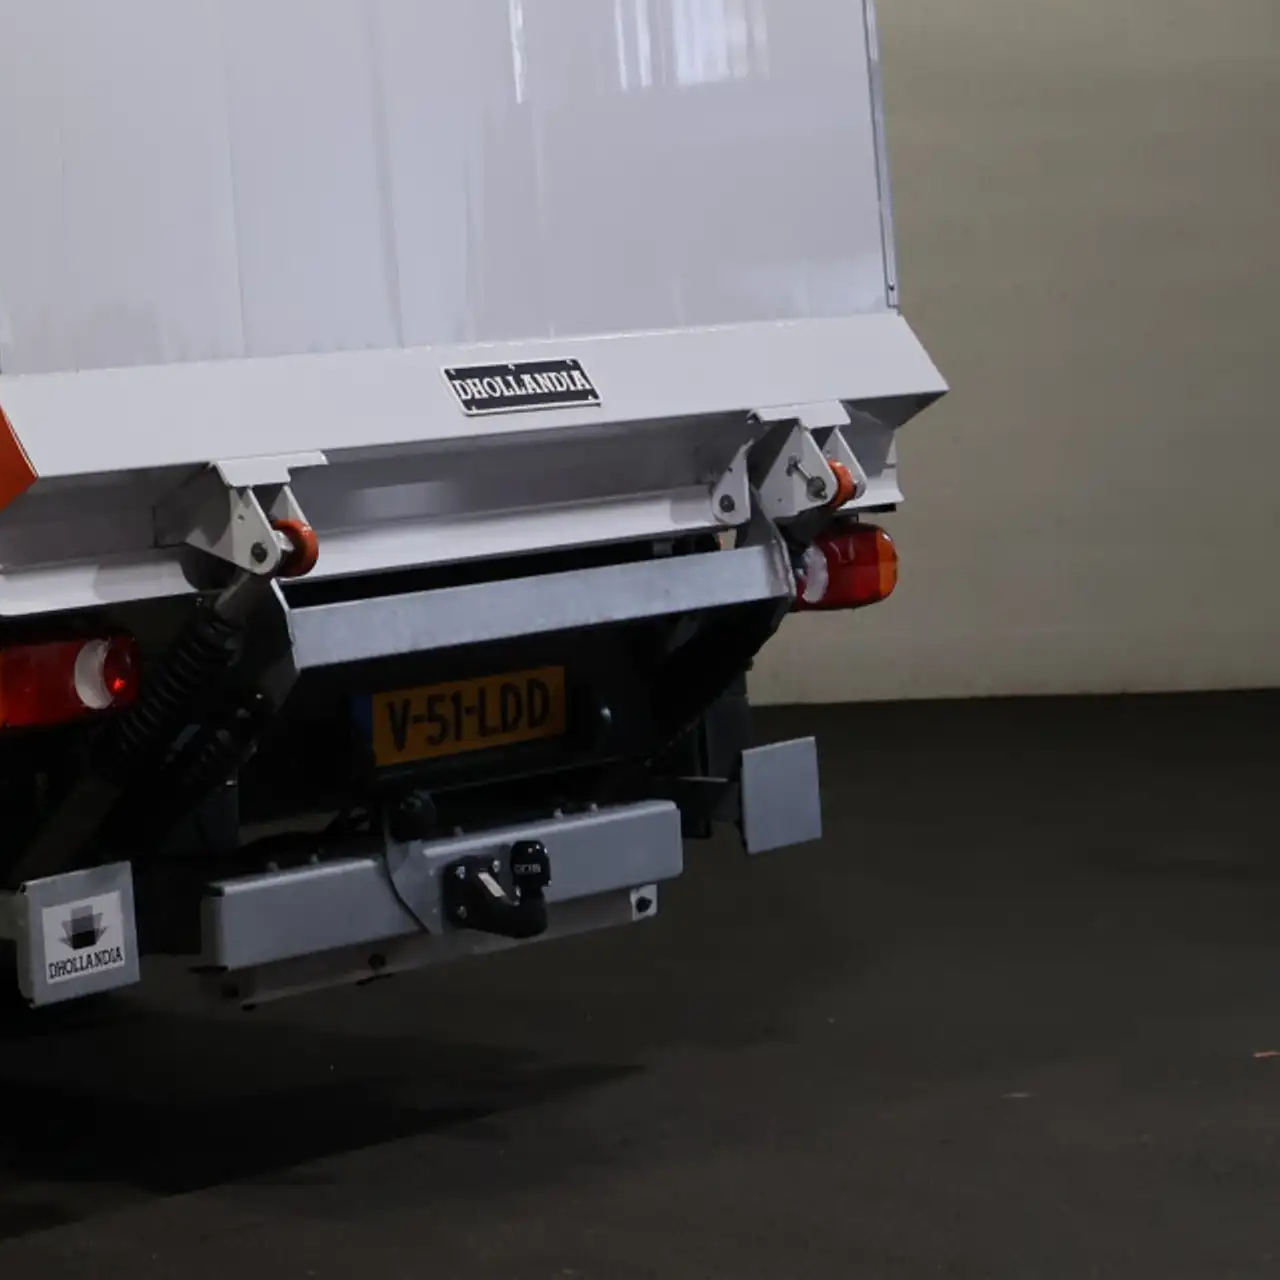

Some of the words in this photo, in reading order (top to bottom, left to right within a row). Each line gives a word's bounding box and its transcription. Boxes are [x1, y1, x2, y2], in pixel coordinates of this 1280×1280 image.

[451, 370, 592, 400] DHOLLANDIA
[387, 678, 550, 752] V-51-LDD
[48, 946, 123, 979] DHOLLANDIA
